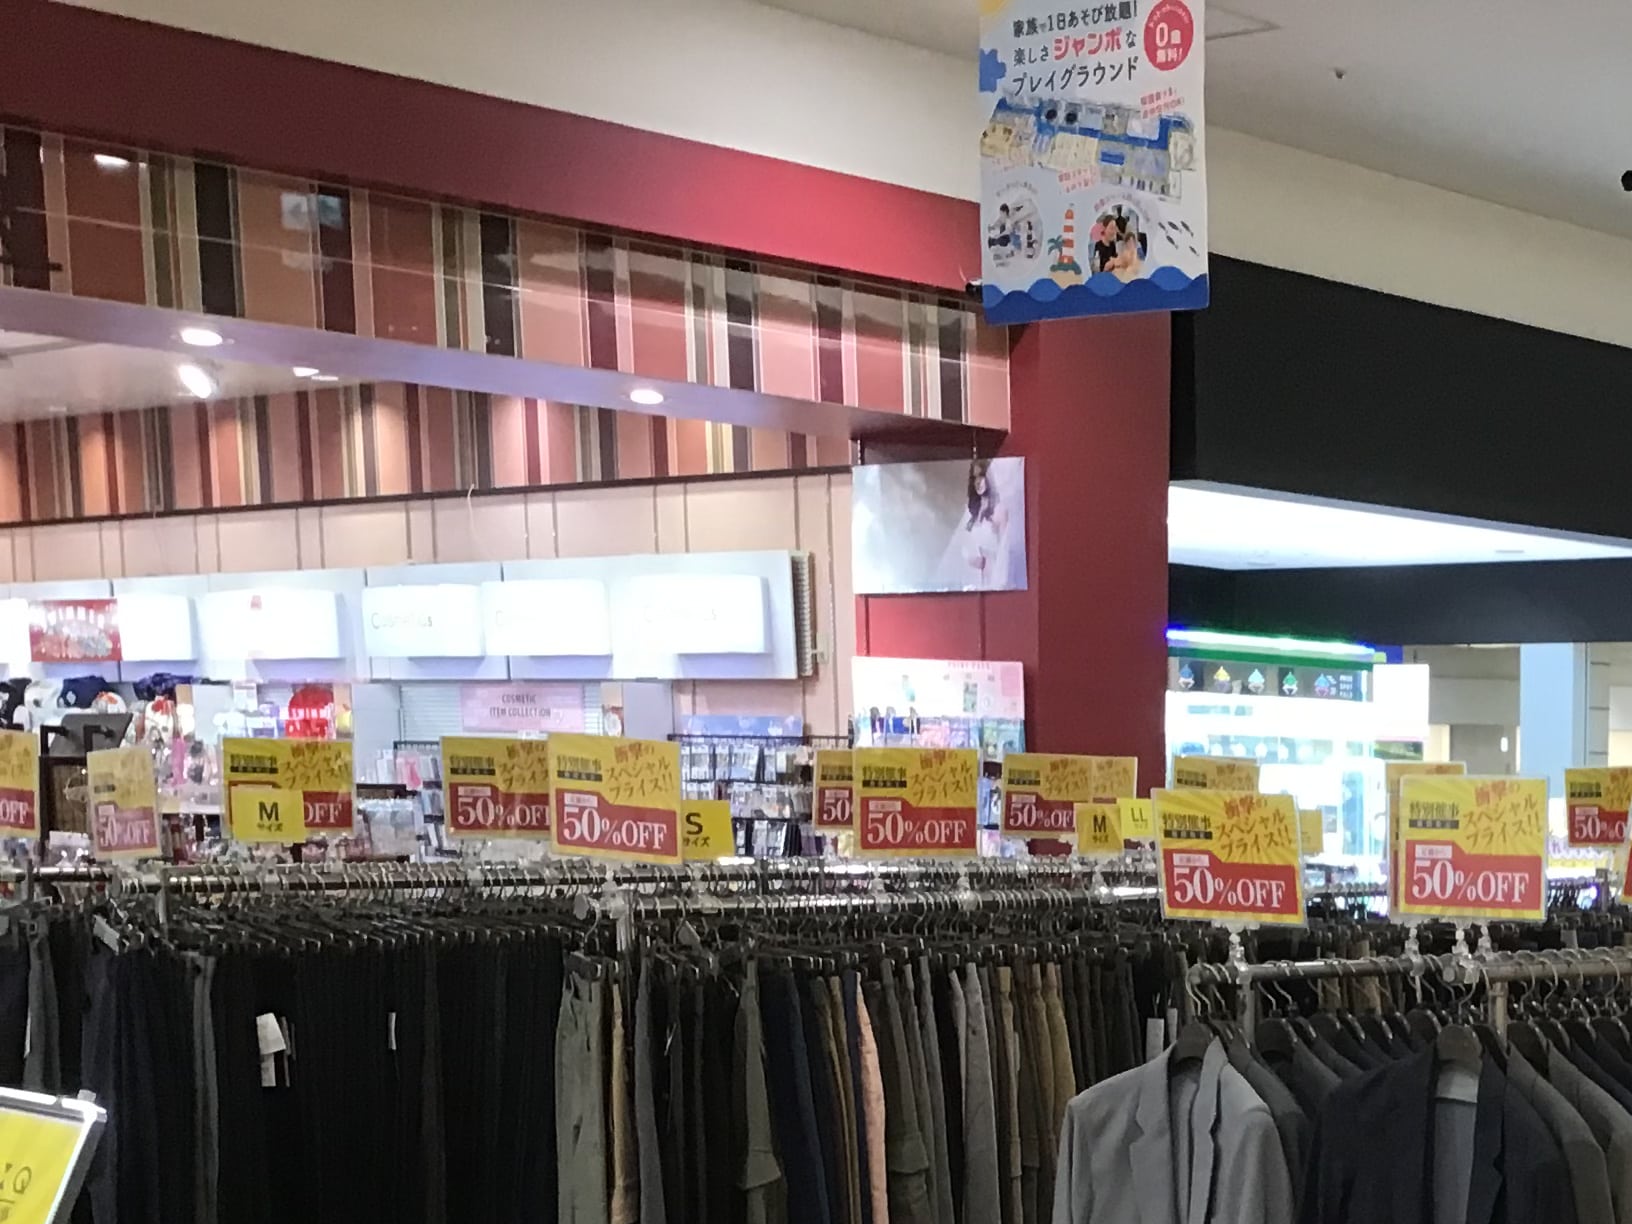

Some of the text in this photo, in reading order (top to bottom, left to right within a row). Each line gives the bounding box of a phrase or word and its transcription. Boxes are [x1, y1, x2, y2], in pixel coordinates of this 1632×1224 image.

[1012, 56, 1140, 97] プレイグラウンド
[258, 801, 280, 822] M
[563, 805, 667, 850] 50%OFF
[685, 812, 704, 836] S
[867, 811, 967, 845] 50%OFF
[1093, 814, 1107, 833] M
[1131, 807, 1148, 822] LL
[1173, 866, 1286, 908] 50%OFF
[1412, 860, 1530, 903] 50%OFF
